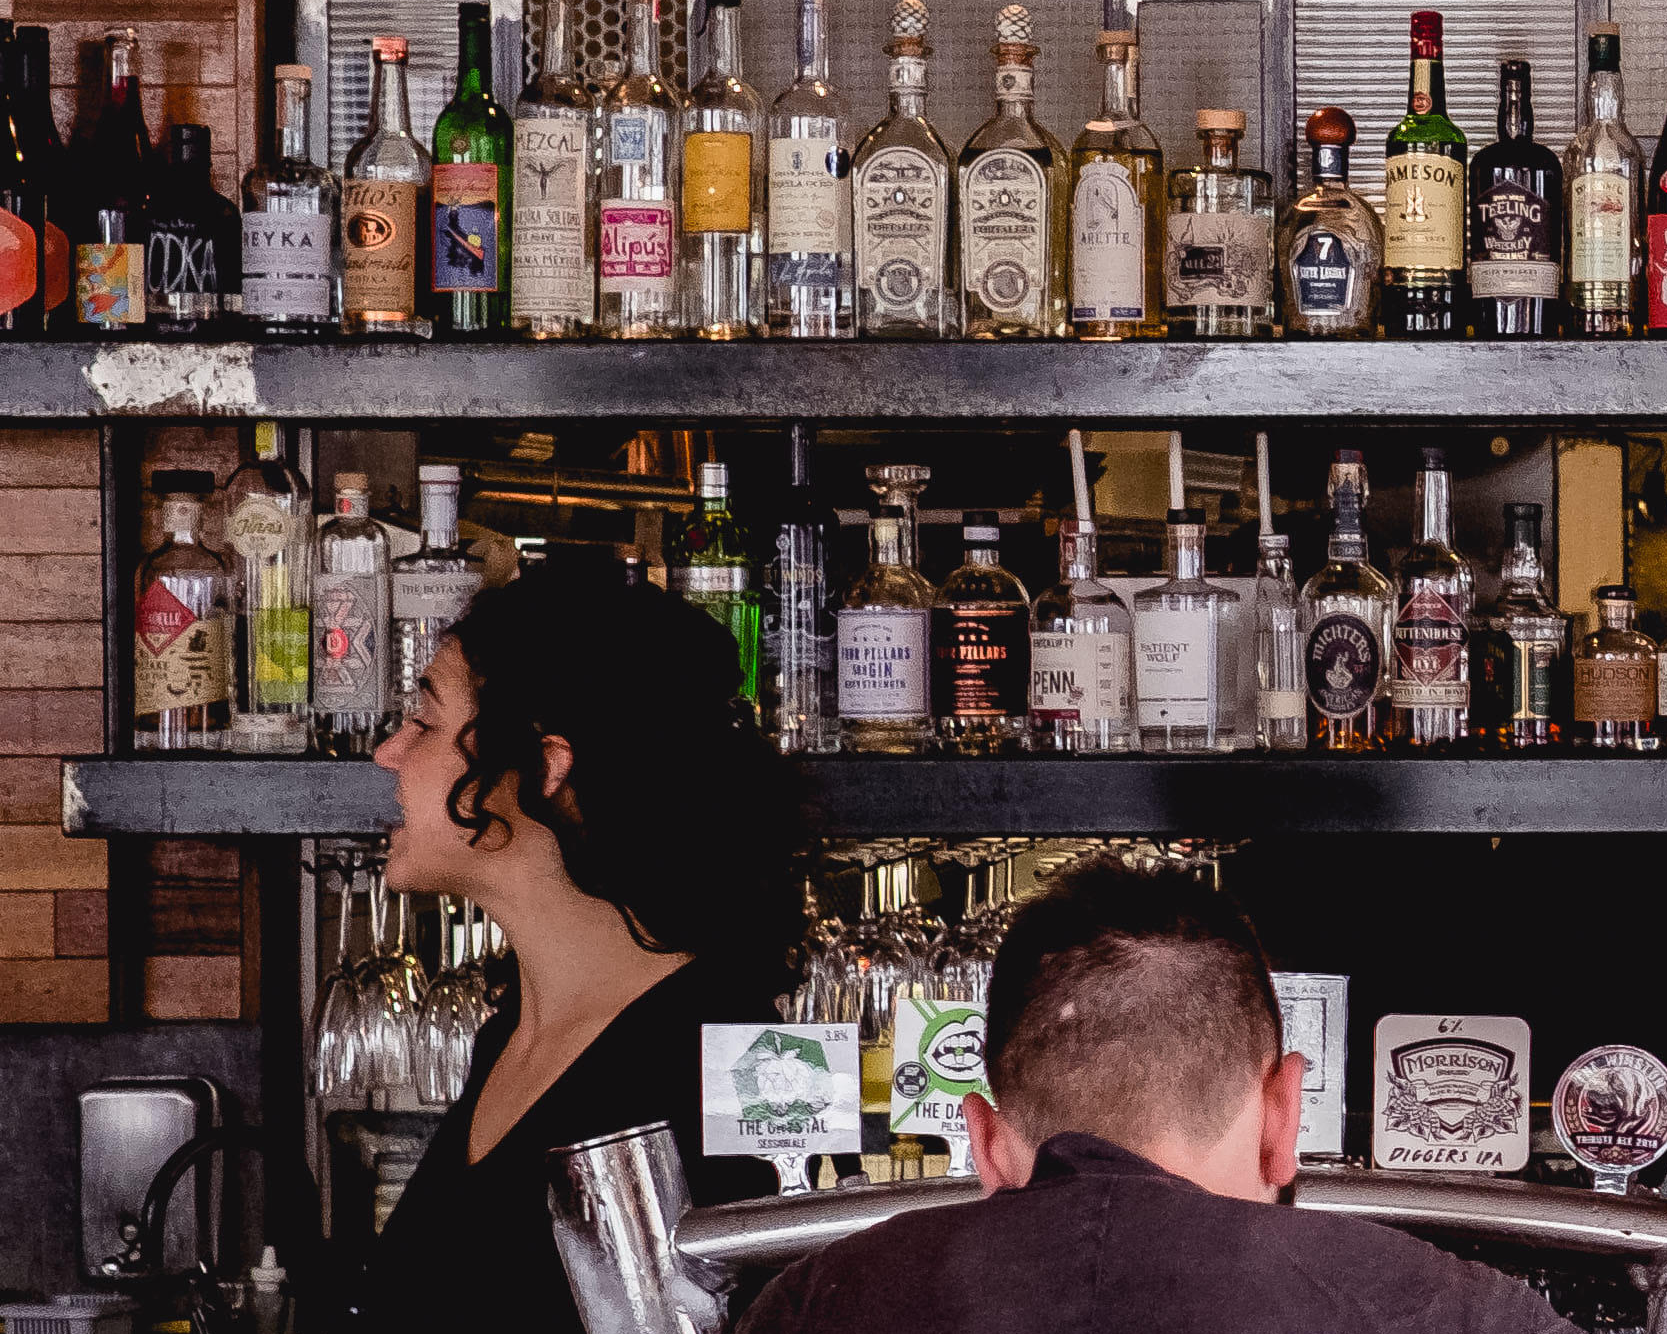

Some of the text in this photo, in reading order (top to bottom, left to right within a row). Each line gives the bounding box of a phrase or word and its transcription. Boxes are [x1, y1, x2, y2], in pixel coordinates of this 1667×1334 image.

[516, 130, 583, 153] MEZCAL
[1386, 164, 1456, 187] JAMESON
[1477, 202, 1541, 223] TEELING
[1317, 237, 1333, 260] 7
[1484, 236, 1533, 251] WHISKEY
[1313, 624, 1371, 662] MICHTER'S
[863, 646, 911, 661] PILLARS
[959, 645, 1007, 660] PILLARS
[868, 661, 893, 678] GIN
[1580, 667, 1650, 681] HUDSON
[1437, 1017, 1464, 1034] 6%
[824, 1029, 849, 1043] 3.8%
[1405, 1051, 1501, 1077] MORRISON
[914, 1102, 940, 1119] THE
[737, 1120, 763, 1136] THE
[941, 1121, 968, 1132] PILSN
[1388, 1146, 1504, 1166] DIGGERS IPA
